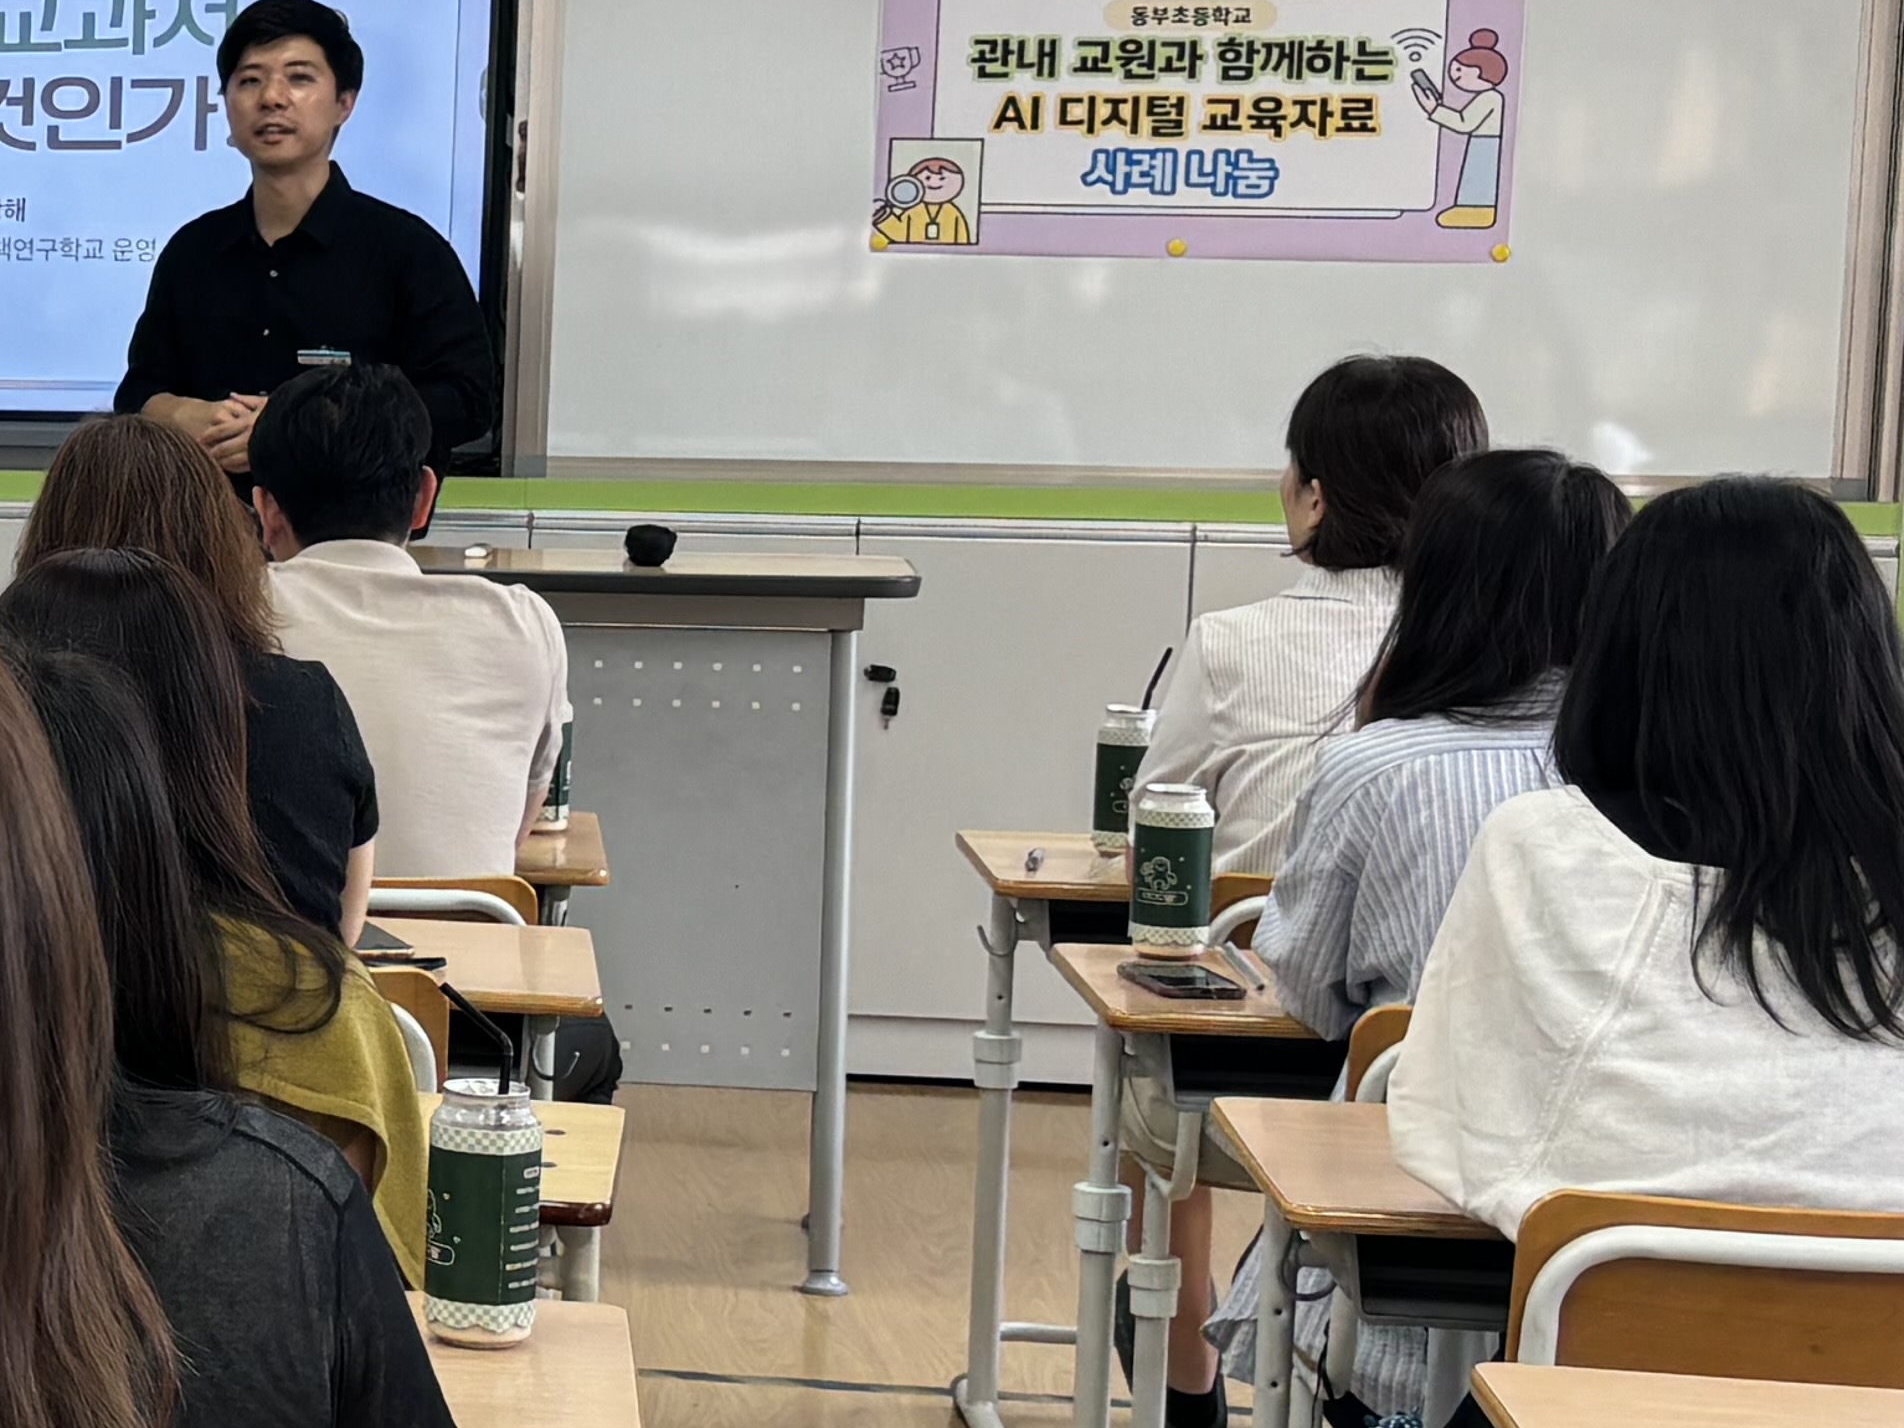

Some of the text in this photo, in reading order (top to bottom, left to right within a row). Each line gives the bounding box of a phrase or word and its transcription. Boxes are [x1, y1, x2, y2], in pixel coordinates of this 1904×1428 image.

[1130, 4, 1252, 26] 동부초등학교
[970, 37, 1393, 81] 관내 교원과 함께하는
[993, 94, 1377, 137] AI 디지털 교육자료
[1081, 148, 1279, 199] 사례 나눔
